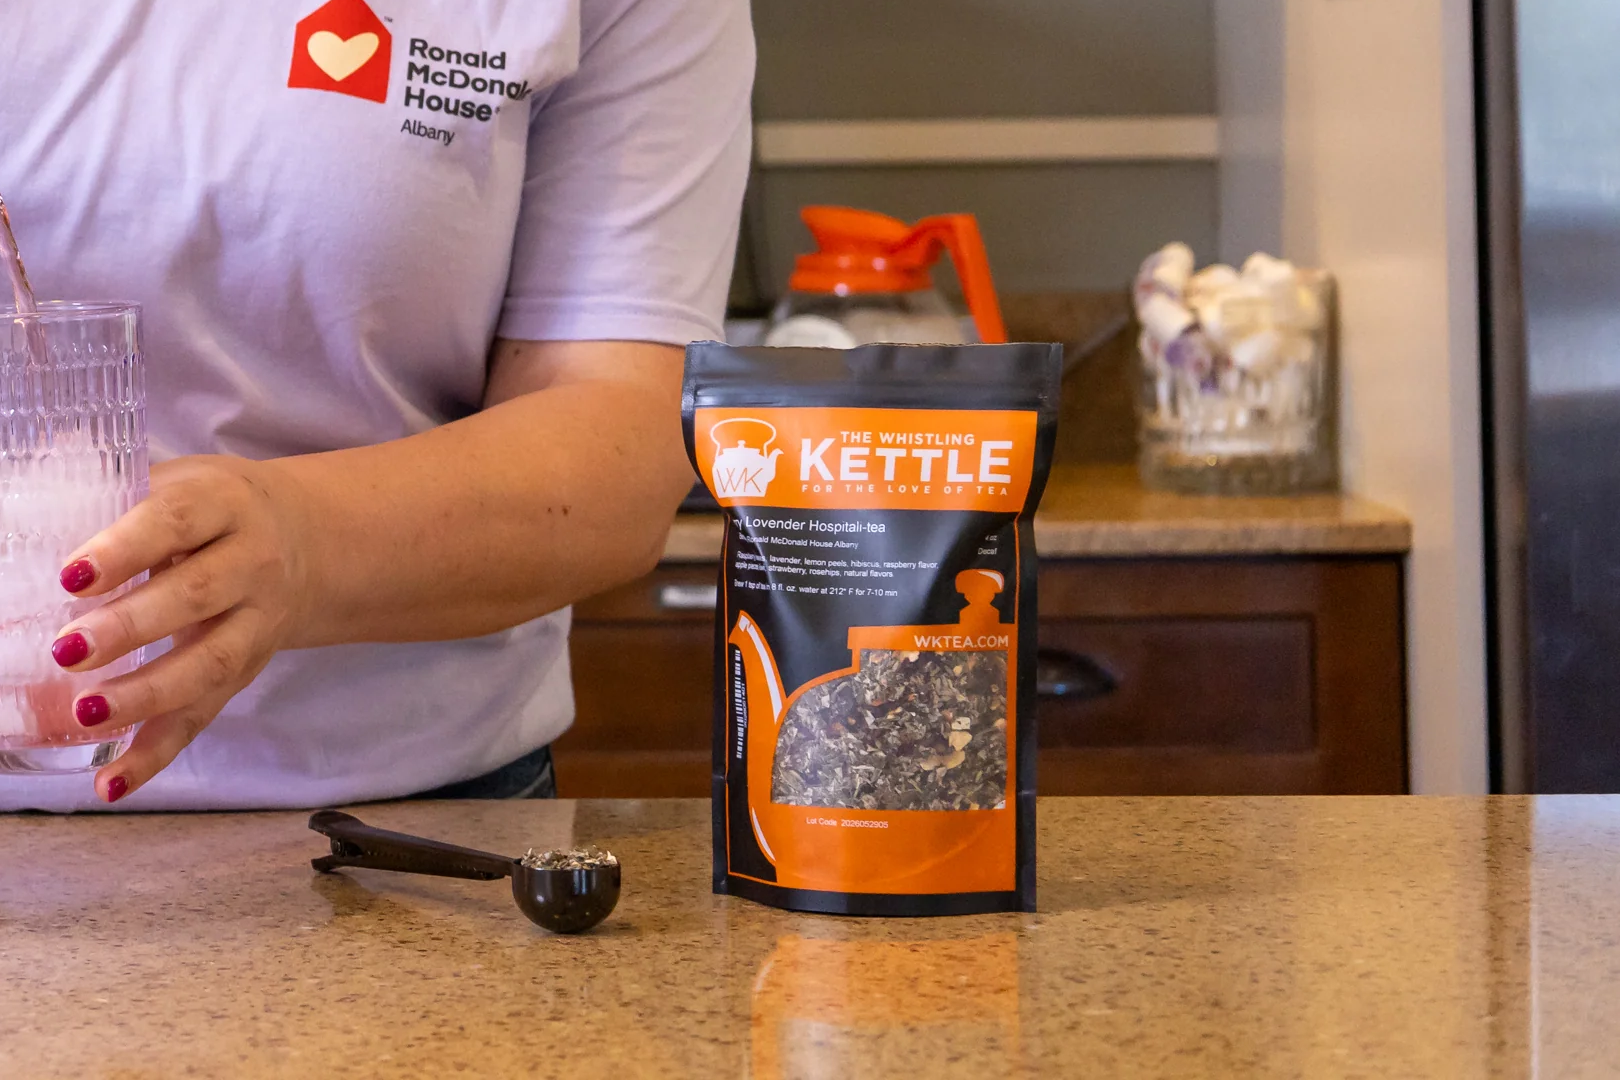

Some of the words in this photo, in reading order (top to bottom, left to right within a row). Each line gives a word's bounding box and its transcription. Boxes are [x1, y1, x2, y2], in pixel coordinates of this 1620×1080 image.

[409, 37, 506, 70] Ronald
[404, 86, 493, 122] House
[400, 119, 455, 147] Albany
[840, 430, 872, 444] THE
[879, 432, 975, 446] WHISTLING
[800, 437, 1013, 484] KETTLE
[716, 467, 763, 493] WK
[801, 484, 833, 493] FOR
[845, 484, 875, 493] THE
[888, 485, 931, 494] LOVE
[944, 486, 963, 495] OF
[977, 486, 1008, 496] TEA
[809, 519, 886, 535] Hospitali-tea
[770, 537, 808, 547] McDonald
[809, 540, 833, 548] House
[834, 541, 858, 550] Albany
[977, 547, 998, 555] Decaf
[769, 555, 803, 565] lavender,
[804, 558, 827, 566] lemon
[850, 560, 881, 568] hibiscus,
[883, 561, 916, 570] raspberry
[771, 583, 777, 591] 8
[799, 586, 819, 594] water
[855, 588, 865, 596] for
[867, 588, 884, 596] 7-10
[913, 635, 1009, 648] WKTEA.COM
[806, 817, 817, 825] Lot
[818, 817, 837, 826] Code
